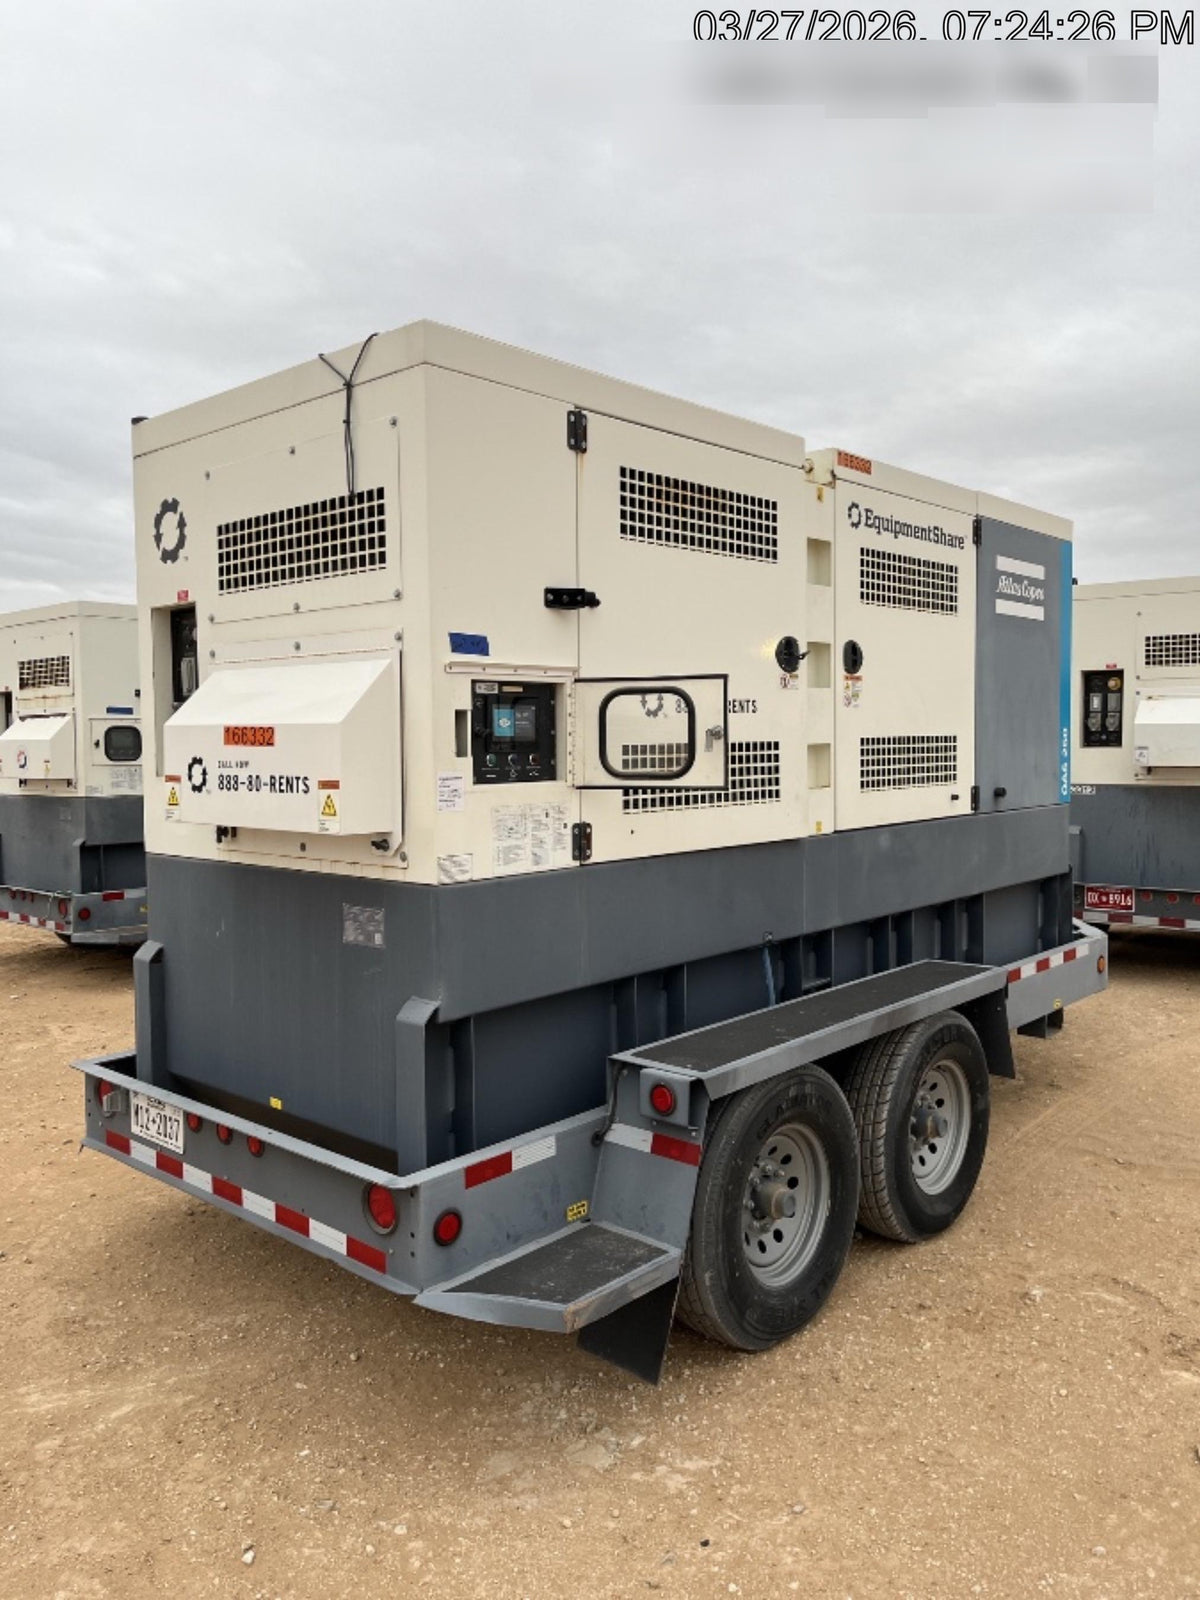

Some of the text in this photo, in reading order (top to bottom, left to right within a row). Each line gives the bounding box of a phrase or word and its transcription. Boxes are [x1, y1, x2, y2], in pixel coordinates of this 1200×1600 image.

[863, 508, 965, 550] EquipmentShare
[995, 575, 1045, 603] Atlas Copco
[224, 727, 275, 747] 166332
[217, 774, 310, 795] 888-80-RENTS
